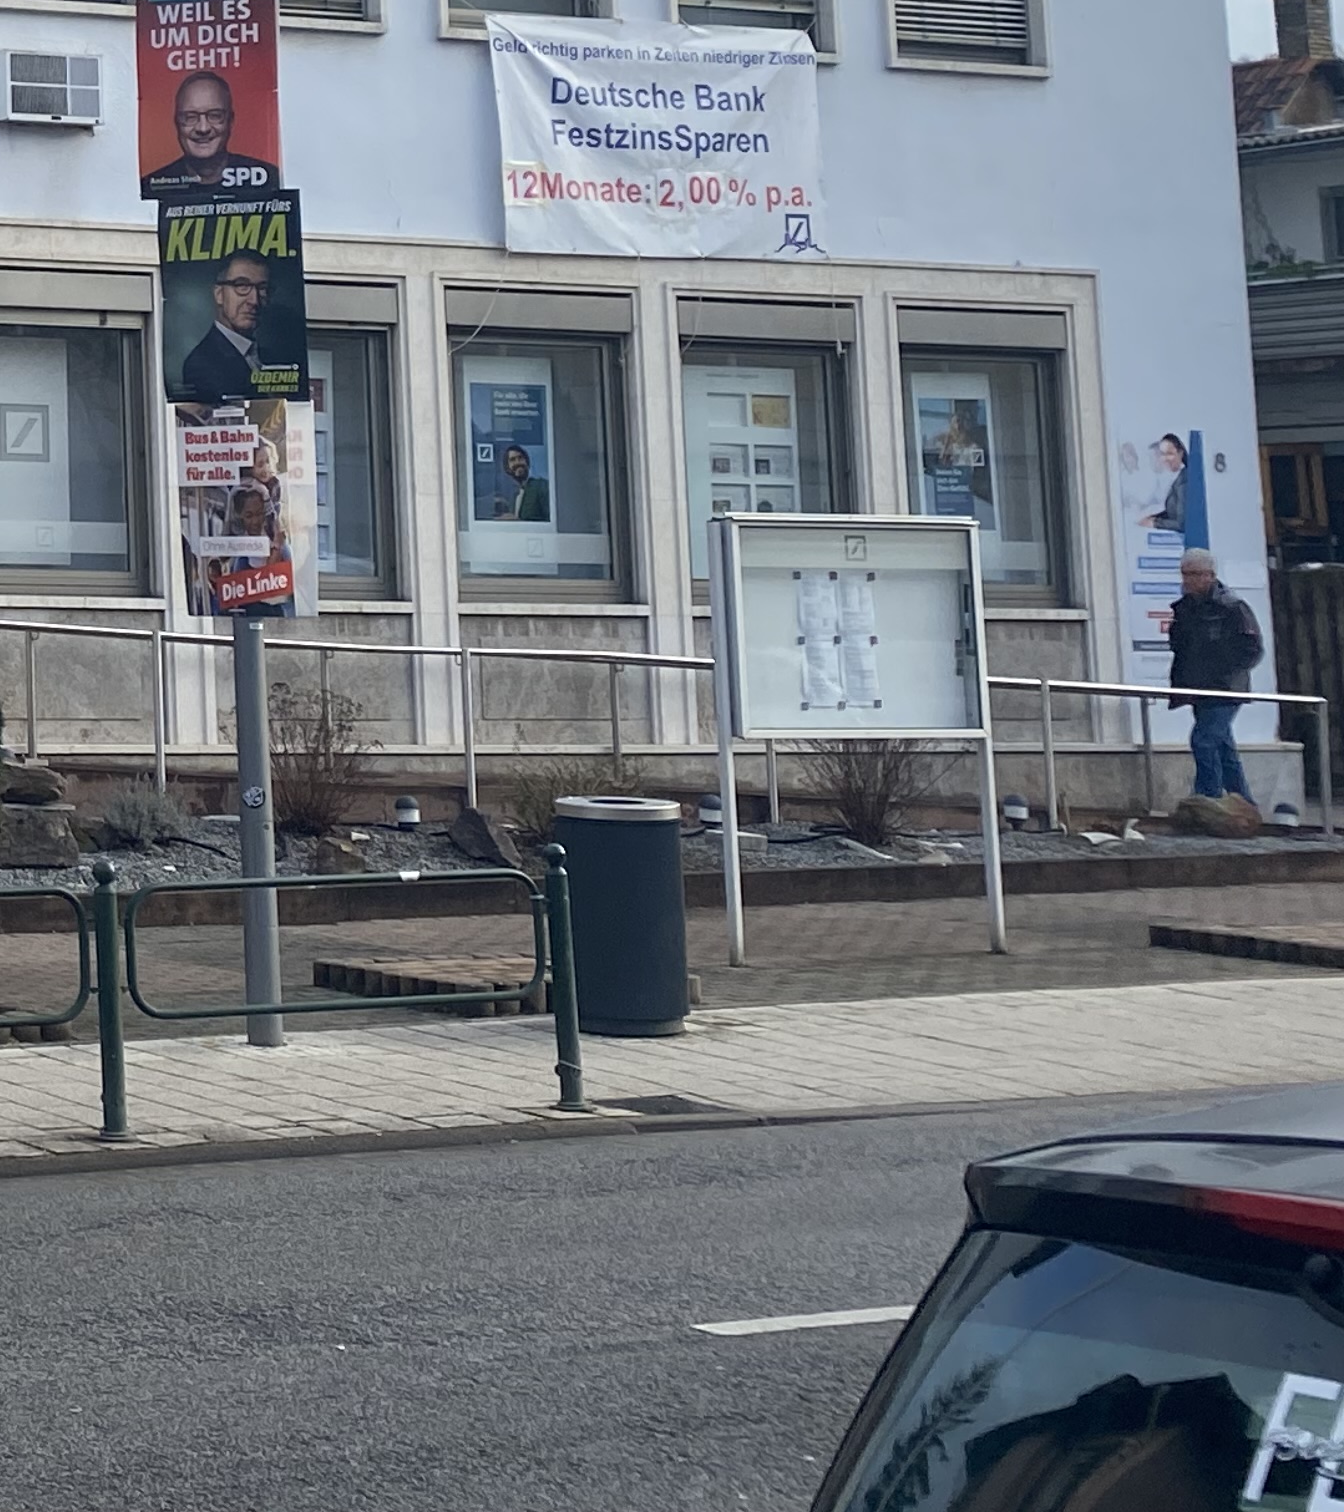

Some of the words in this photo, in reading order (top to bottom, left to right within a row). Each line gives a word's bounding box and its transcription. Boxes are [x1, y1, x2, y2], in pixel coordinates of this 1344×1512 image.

[156, 1, 216, 25] WEIL
[222, 0, 252, 21] ES
[150, 26, 191, 49] UM
[198, 22, 259, 46] DICH
[167, 46, 241, 71] GEHT!
[583, 44, 634, 61] parken
[637, 45, 651, 61] in
[654, 47, 700, 63] Zeiten
[703, 50, 764, 68] niedriger
[551, 76, 686, 111] Deutsche
[694, 84, 767, 113] Bank
[551, 119, 770, 159] FestzinsSparen
[221, 166, 268, 187] SPD
[165, 206, 183, 218] AUS
[215, 201, 265, 215] VERNUNFT
[265, 198, 292, 213] FÜRS
[765, 184, 814, 212] p.a.
[165, 213, 297, 262] KLIMA.
[219, 429, 254, 444] Bahn
[185, 448, 250, 463] kostenlos
[1214, 452, 1227, 473] 8
[186, 466, 206, 481] für
[207, 466, 236, 480] alle.
[222, 580, 245, 602] Die
[246, 571, 288, 595] Linke
